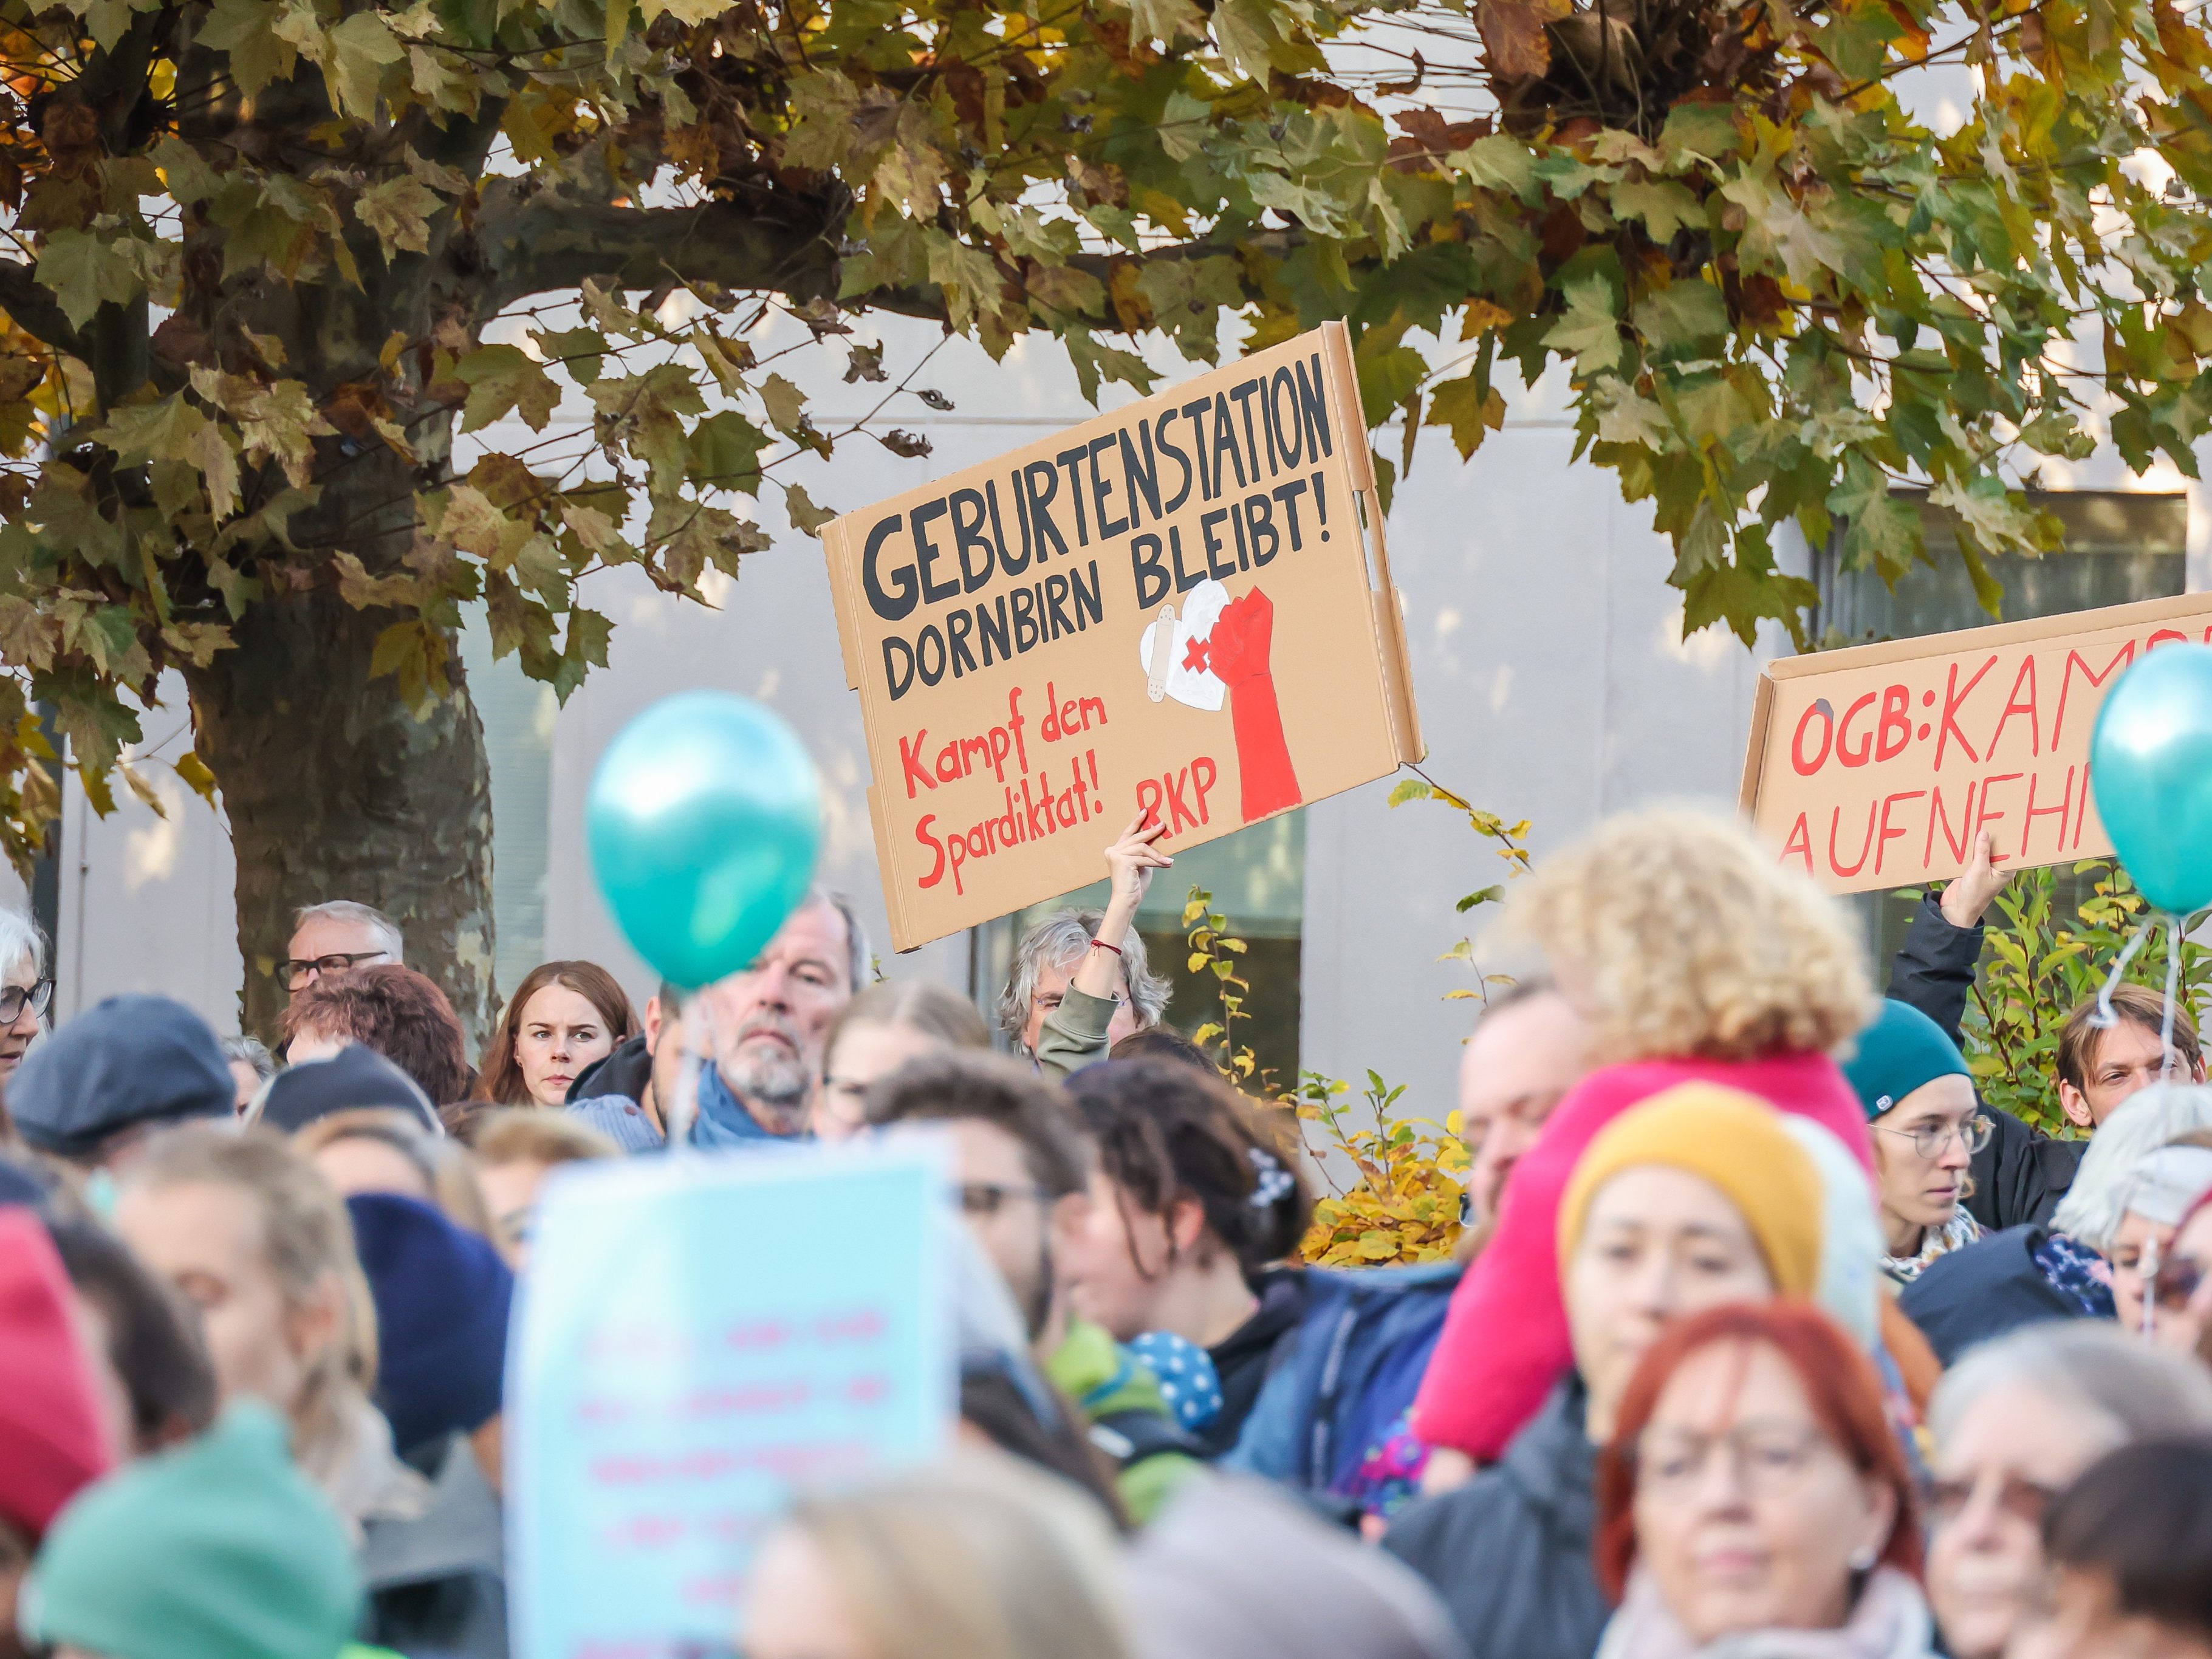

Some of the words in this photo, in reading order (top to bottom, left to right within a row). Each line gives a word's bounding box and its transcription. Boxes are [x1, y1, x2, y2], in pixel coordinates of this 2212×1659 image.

[861, 353, 1333, 621] GEBURTENSTATION
[882, 560, 1104, 701] DORNBIRN
[1131, 471, 1330, 610] BLEIBT!
[899, 686, 1029, 799] Kampf
[1135, 756, 1217, 847] RKP
[916, 748, 1103, 896] Spardiktat!
[1778, 761, 2092, 880] AUFNEH
